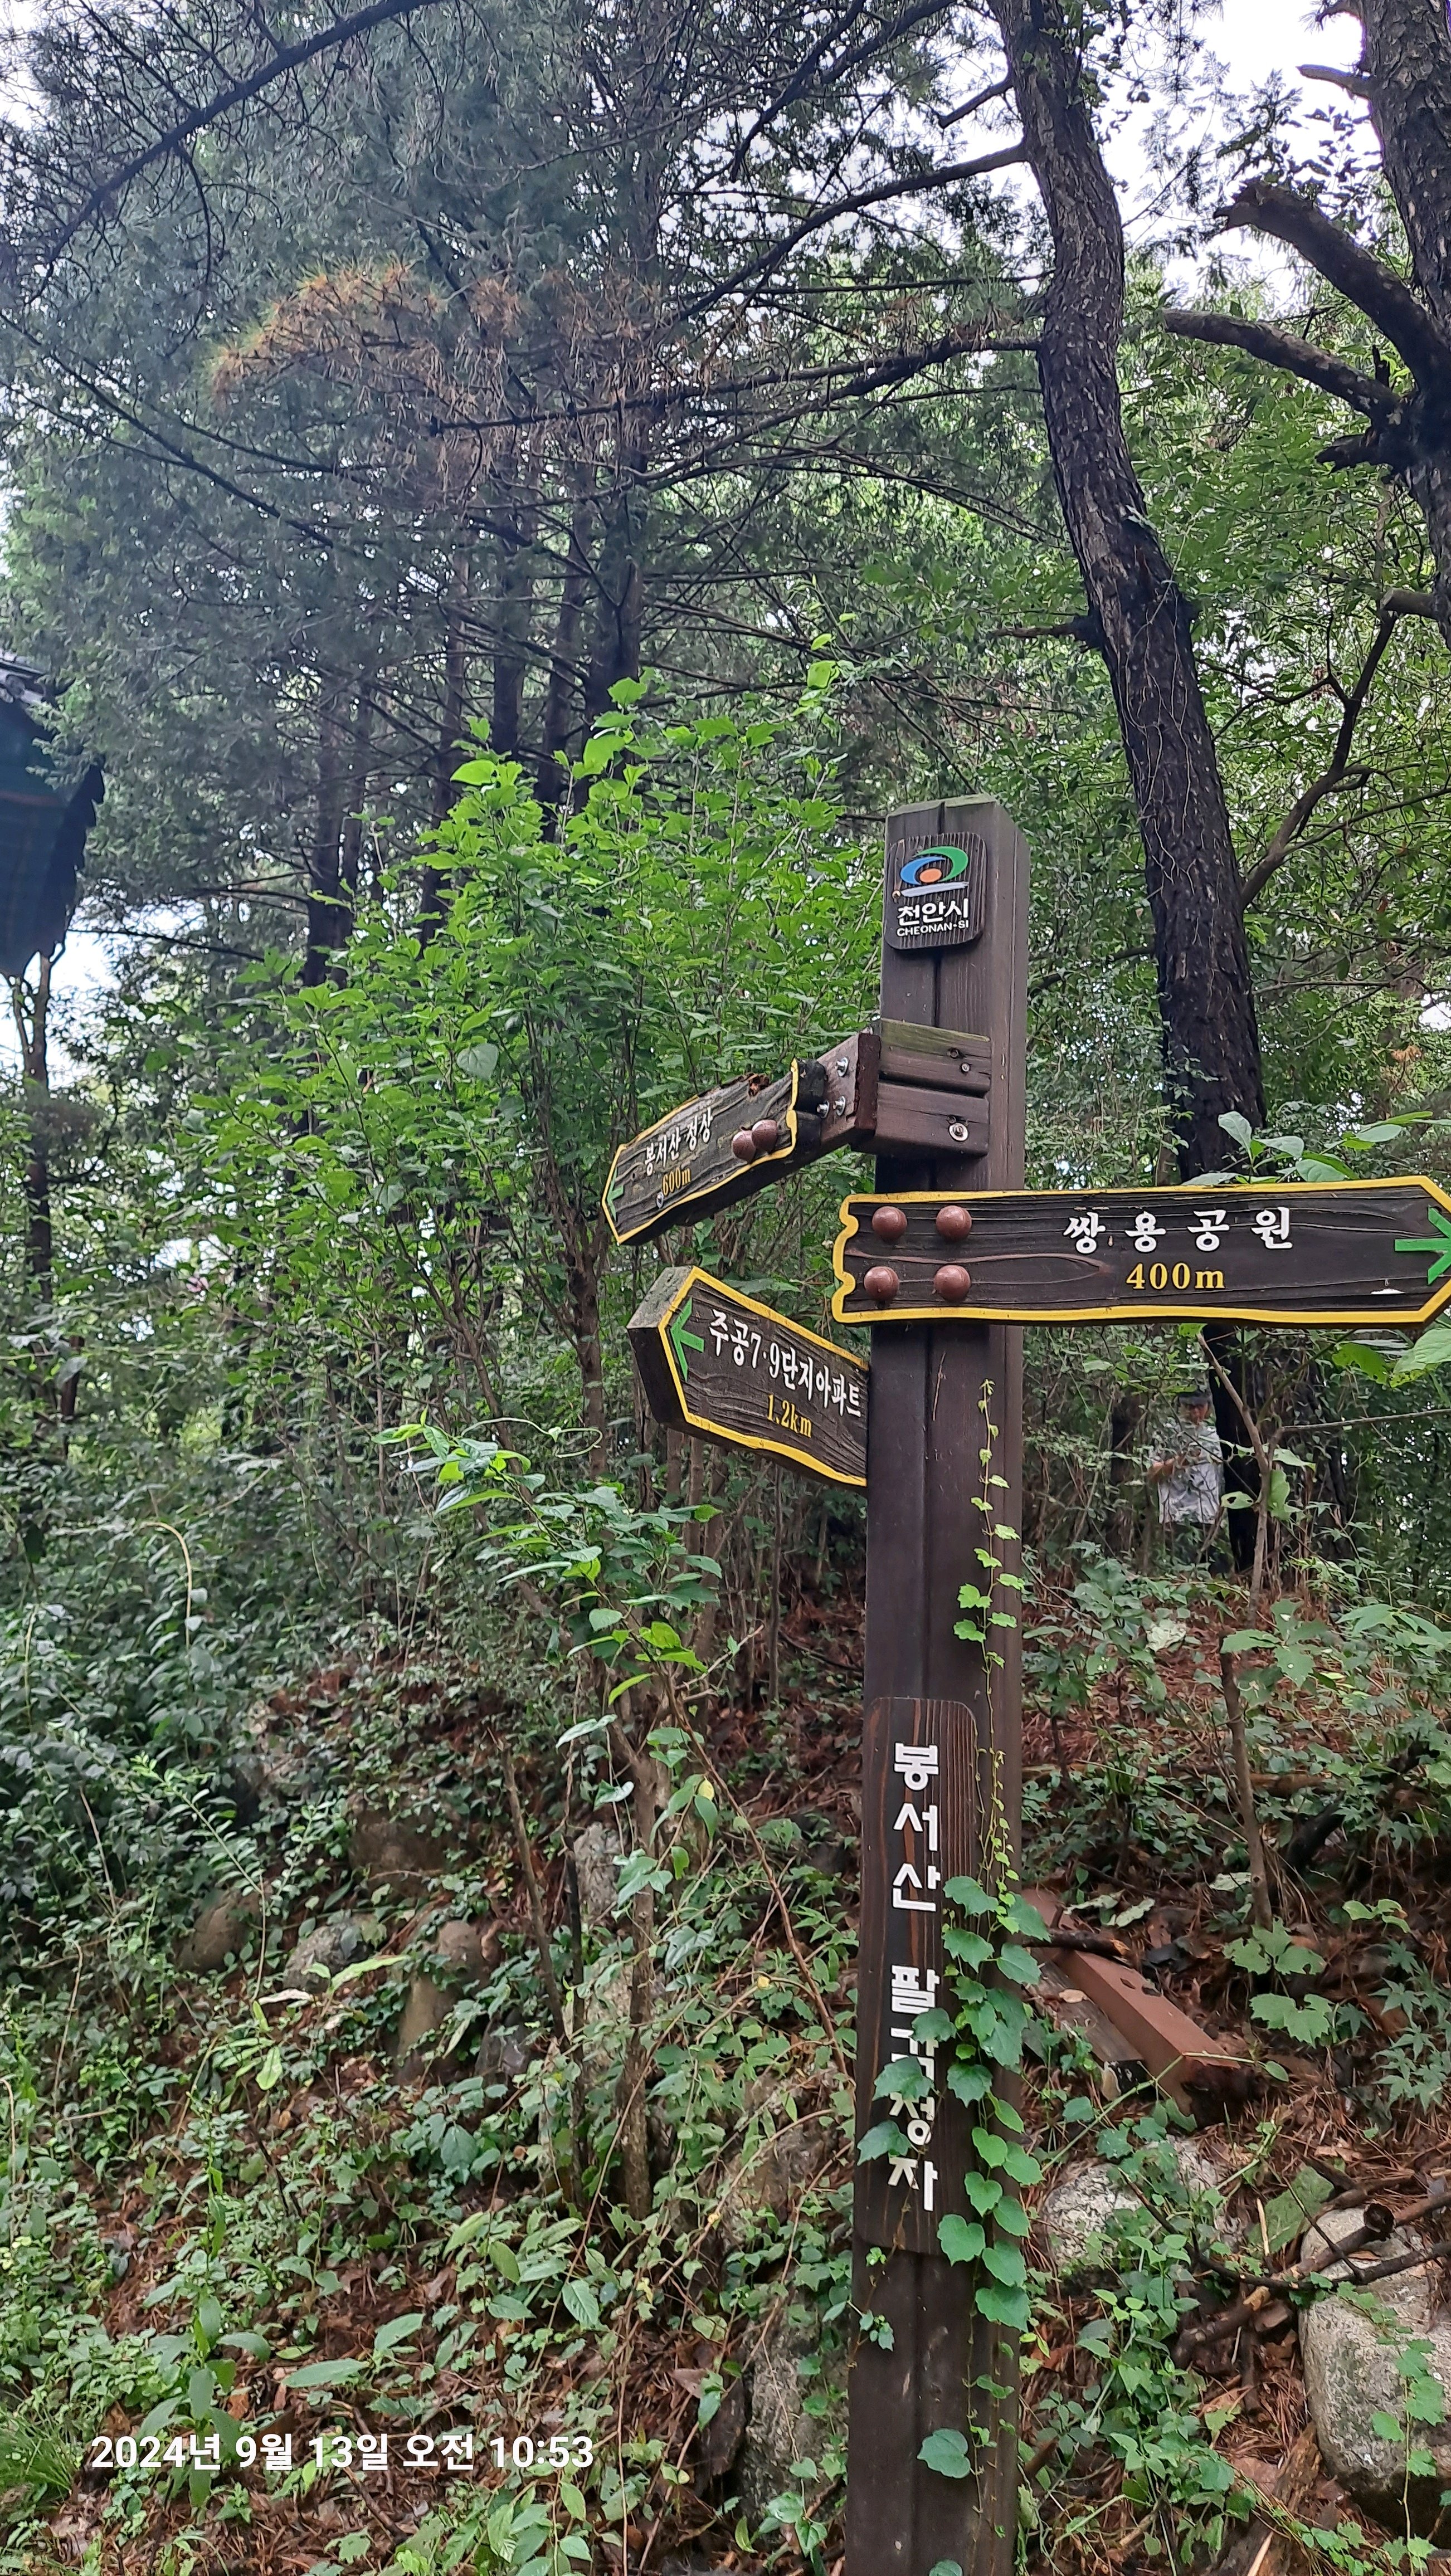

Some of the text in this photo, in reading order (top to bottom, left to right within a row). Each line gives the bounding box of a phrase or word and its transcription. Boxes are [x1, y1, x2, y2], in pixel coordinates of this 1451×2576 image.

[897, 898, 968, 926] 천안시
[897, 919, 969, 936] CHEONAN-SI
[645, 1107, 713, 1175] 봉서산 정상
[663, 1168, 691, 1196] 600m
[1063, 1207, 1293, 1254] 쌍용공원
[1126, 1262, 1225, 1290] 400m
[767, 1394, 812, 1438] 1.2km
[893, 1743, 941, 1912] 봉서산
